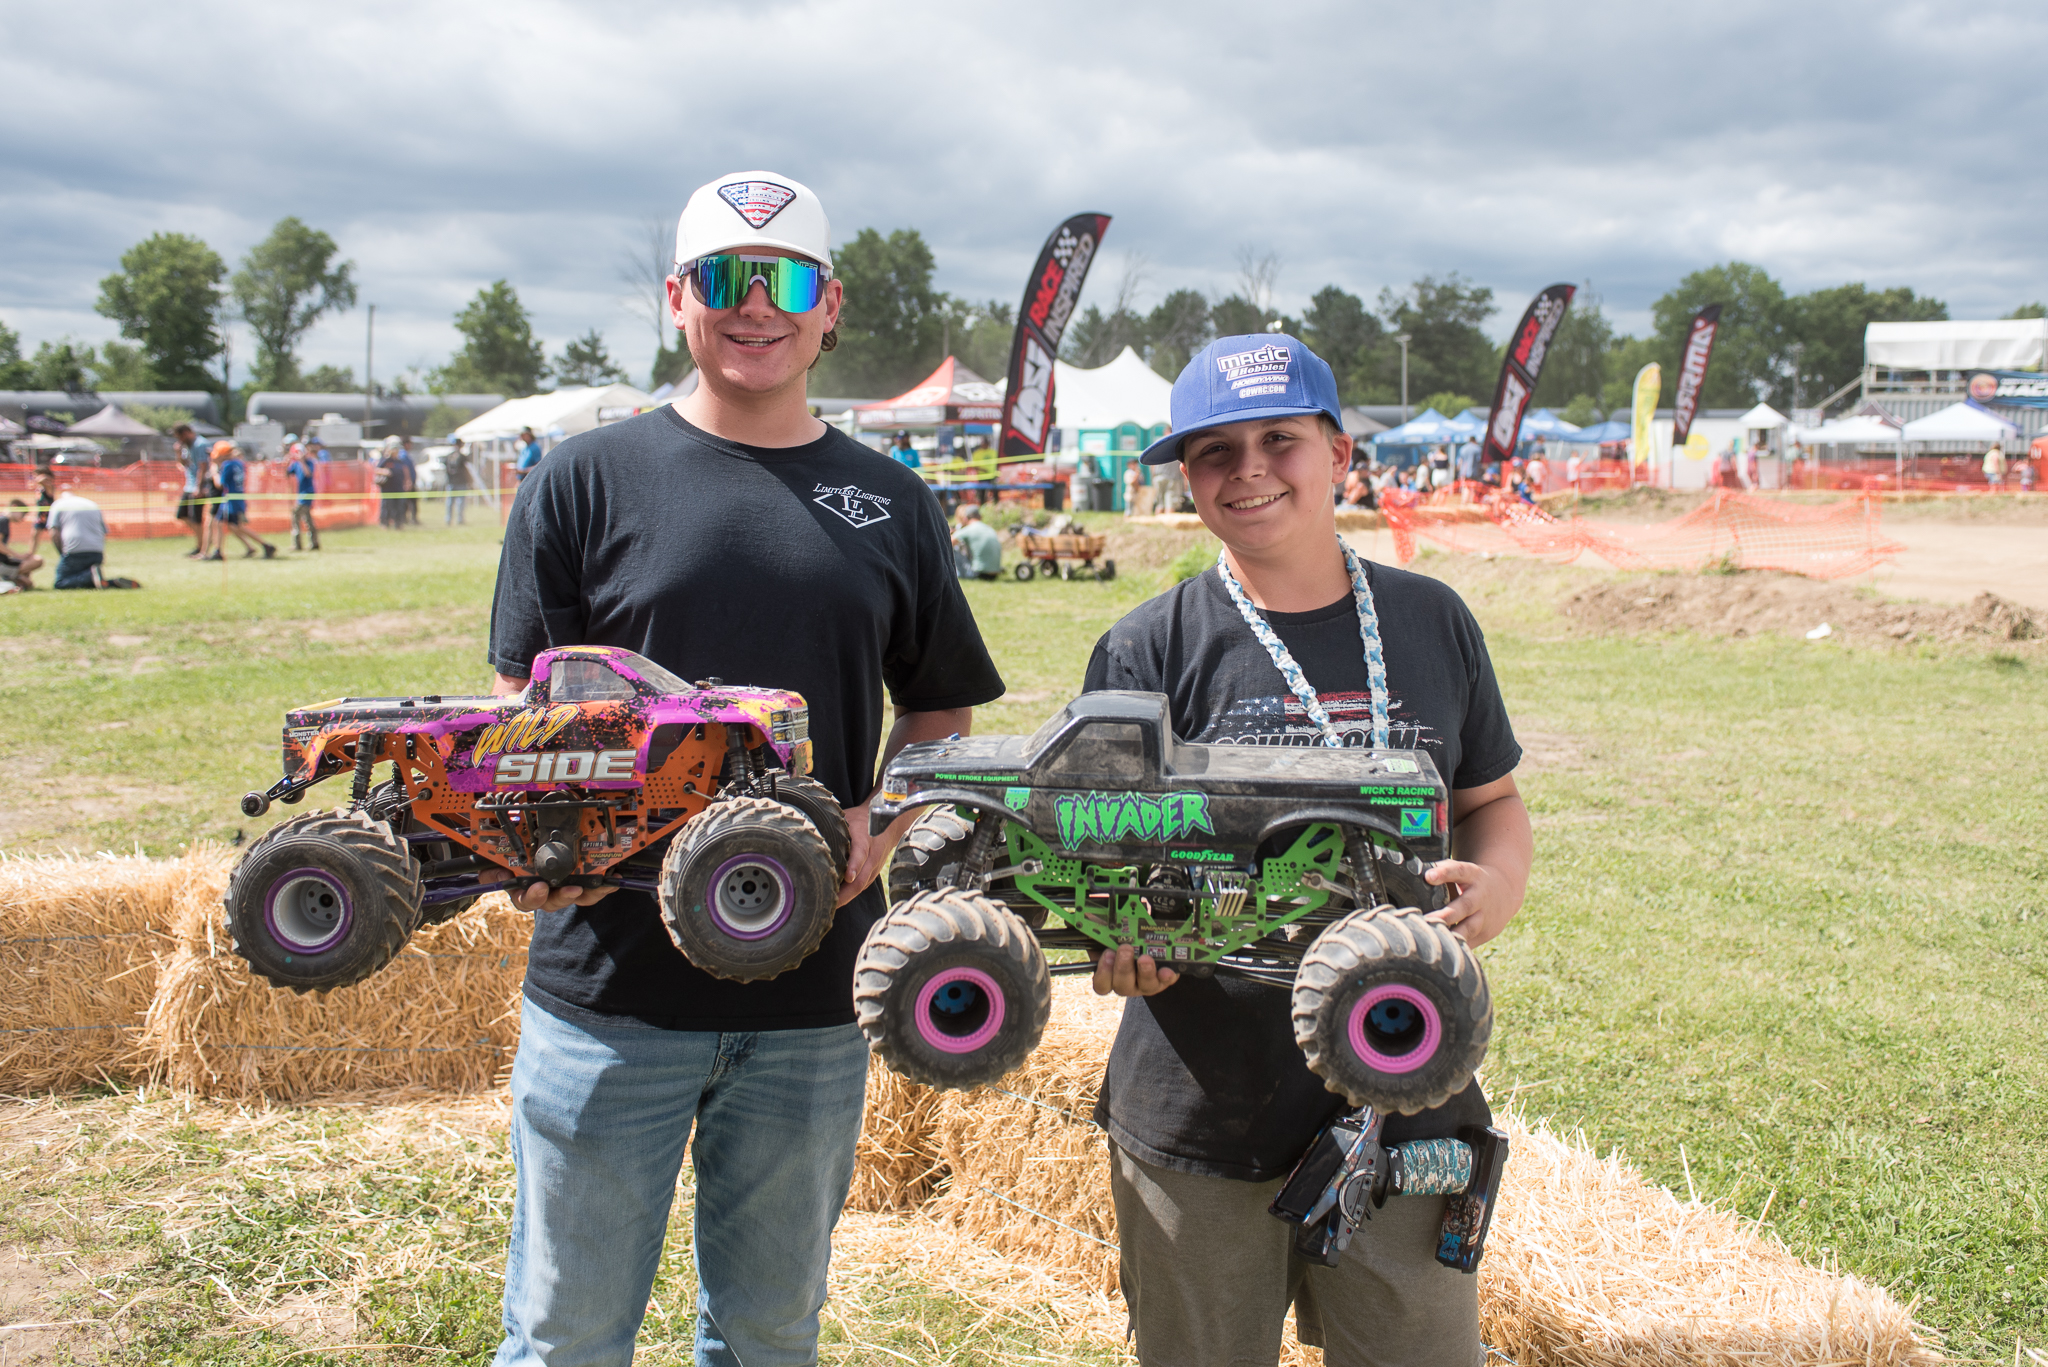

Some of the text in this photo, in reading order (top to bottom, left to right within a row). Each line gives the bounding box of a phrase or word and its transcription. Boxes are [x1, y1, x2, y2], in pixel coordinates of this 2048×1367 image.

[1028, 257, 1065, 329] RACE
[1043, 232, 1095, 344] INSPIRED
[1219, 346, 1289, 370] MAGIC
[1239, 363, 1285, 376] Hobbies
[1241, 385, 1285, 397] COWRC.COM
[854, 489, 892, 506] LIGHTING
[471, 703, 580, 768] WILD
[493, 750, 638, 785] SIDE
[935, 773, 957, 781] POWER
[958, 774, 982, 782] STROKE
[1360, 786, 1435, 796] WICK'S RACING
[1370, 797, 1425, 806] PRODUCTS
[1054, 789, 1216, 851] INVADER
[1170, 849, 1235, 862] GOODYEAR
[1438, 1232, 1462, 1261] 25
